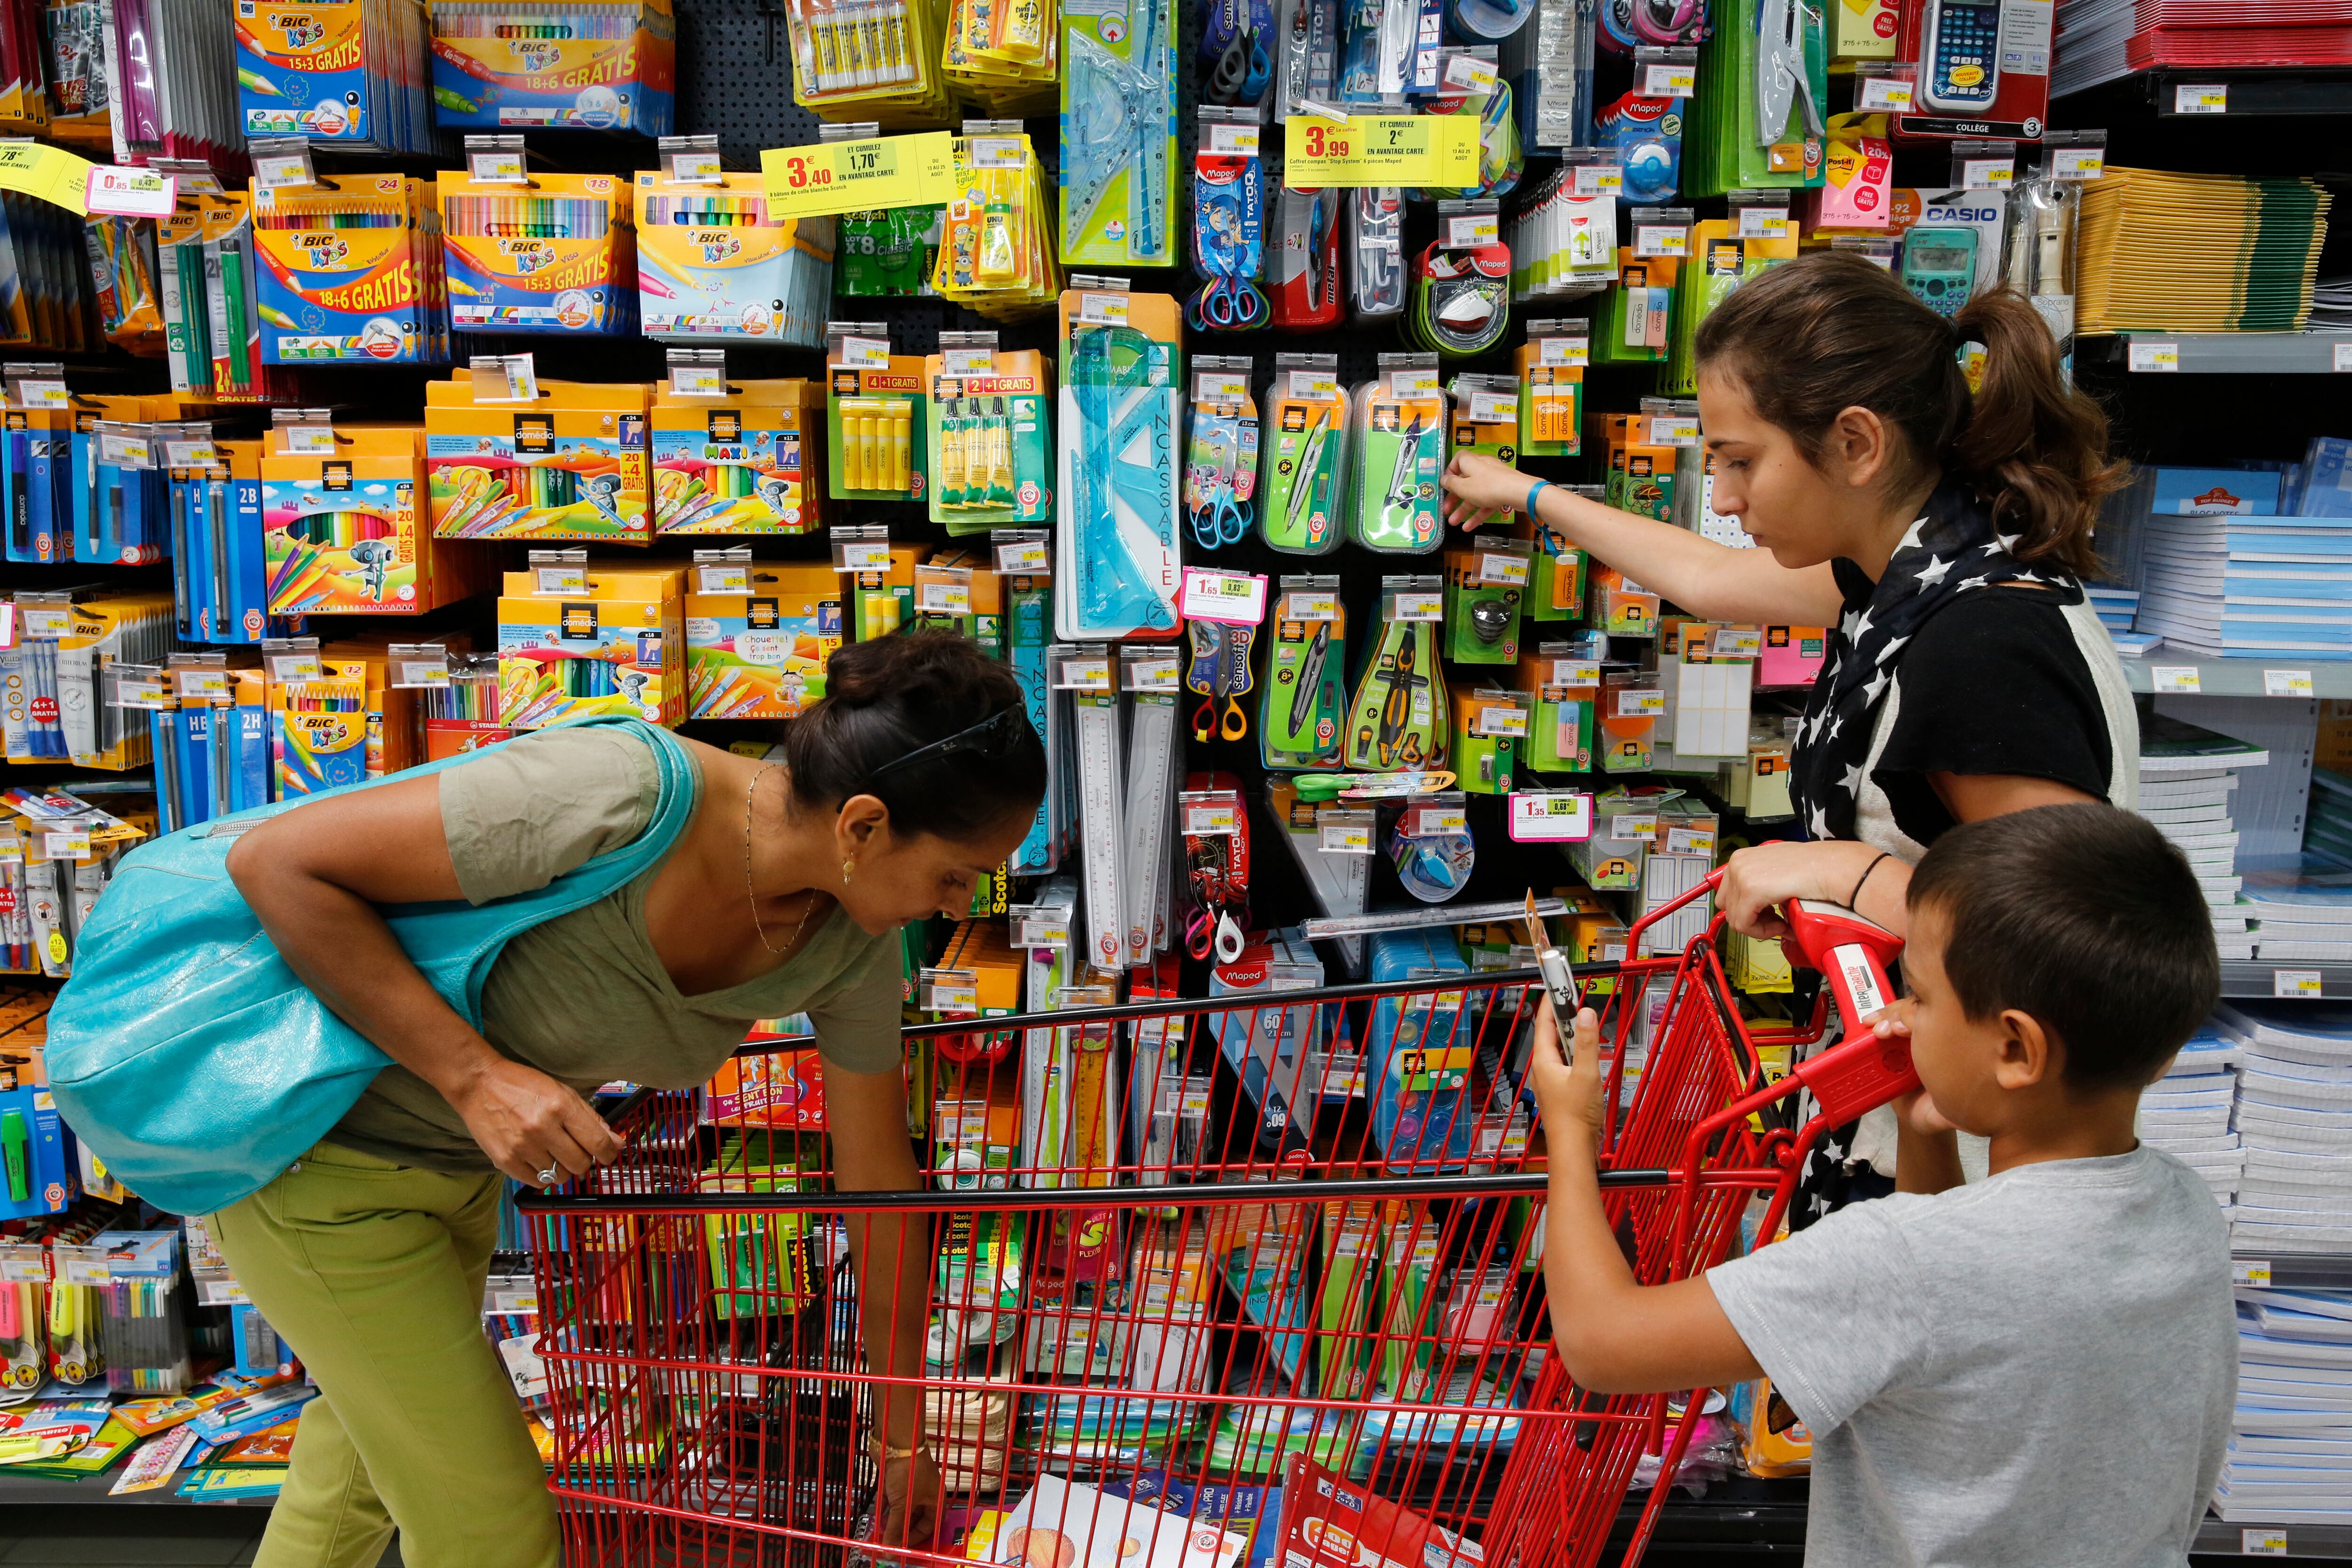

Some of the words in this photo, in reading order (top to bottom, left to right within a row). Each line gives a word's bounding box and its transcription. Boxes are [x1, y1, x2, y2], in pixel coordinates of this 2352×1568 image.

[289, 57, 314, 70] 15+3
[316, 32, 361, 71] GRATIS
[525, 75, 558, 89] 18+6
[563, 46, 636, 88] GRATIS
[1630, 103, 1661, 113] Maped
[1956, 124, 1989, 133] COLLÈGE
[2027, 122, 2036, 131] 3
[1868, 147, 1888, 159] 20%
[850, 152, 880, 171] 1,70€
[848, 171, 875, 180] AVANTAGE
[1207, 169, 1235, 178] Maped
[380, 180, 398, 189] 24
[588, 179, 609, 188] 18
[1927, 207, 1996, 222] CASIO
[861, 237, 875, 253] 8
[898, 237, 913, 245] Colle
[877, 243, 913, 255] Classic
[1708, 252, 1743, 264] domédia
[524, 278, 551, 290] 15+3
[555, 246, 609, 289] GRATIS
[1479, 259, 1507, 269] Maped
[318, 292, 349, 309] 18+6
[352, 259, 412, 310] GRATIS
[1326, 265, 1335, 305] metal
[2037, 298, 2069, 307] Soprano
[891, 379, 917, 388] GRATIS
[935, 384, 963, 394] domédia
[971, 381, 980, 391] 2
[999, 380, 1032, 390] GRATIS
[710, 422, 740, 432] domédia
[516, 428, 554, 440] domédia
[625, 453, 639, 462] 20
[705, 444, 748, 460] MAXI
[624, 463, 640, 475] +4
[324, 470, 351, 481] domédia
[623, 477, 644, 490] GRATIS
[240, 488, 257, 503] 2B
[398, 511, 413, 521] 20
[398, 525, 413, 539] +4
[400, 540, 414, 563] GRATIS
[748, 610, 778, 619] domédia
[562, 617, 596, 628] domédia
[1280, 627, 1304, 635] domédia
[1230, 631, 1250, 644] 3D
[749, 653, 764, 661] trop
[1234, 644, 1244, 689] sensoft
[32, 701, 54, 710] 4+1
[190, 716, 207, 731] HB
[243, 714, 261, 729] 2H
[1226, 971, 1261, 980] Maped
[30, 1426, 69, 1438] STABILO
